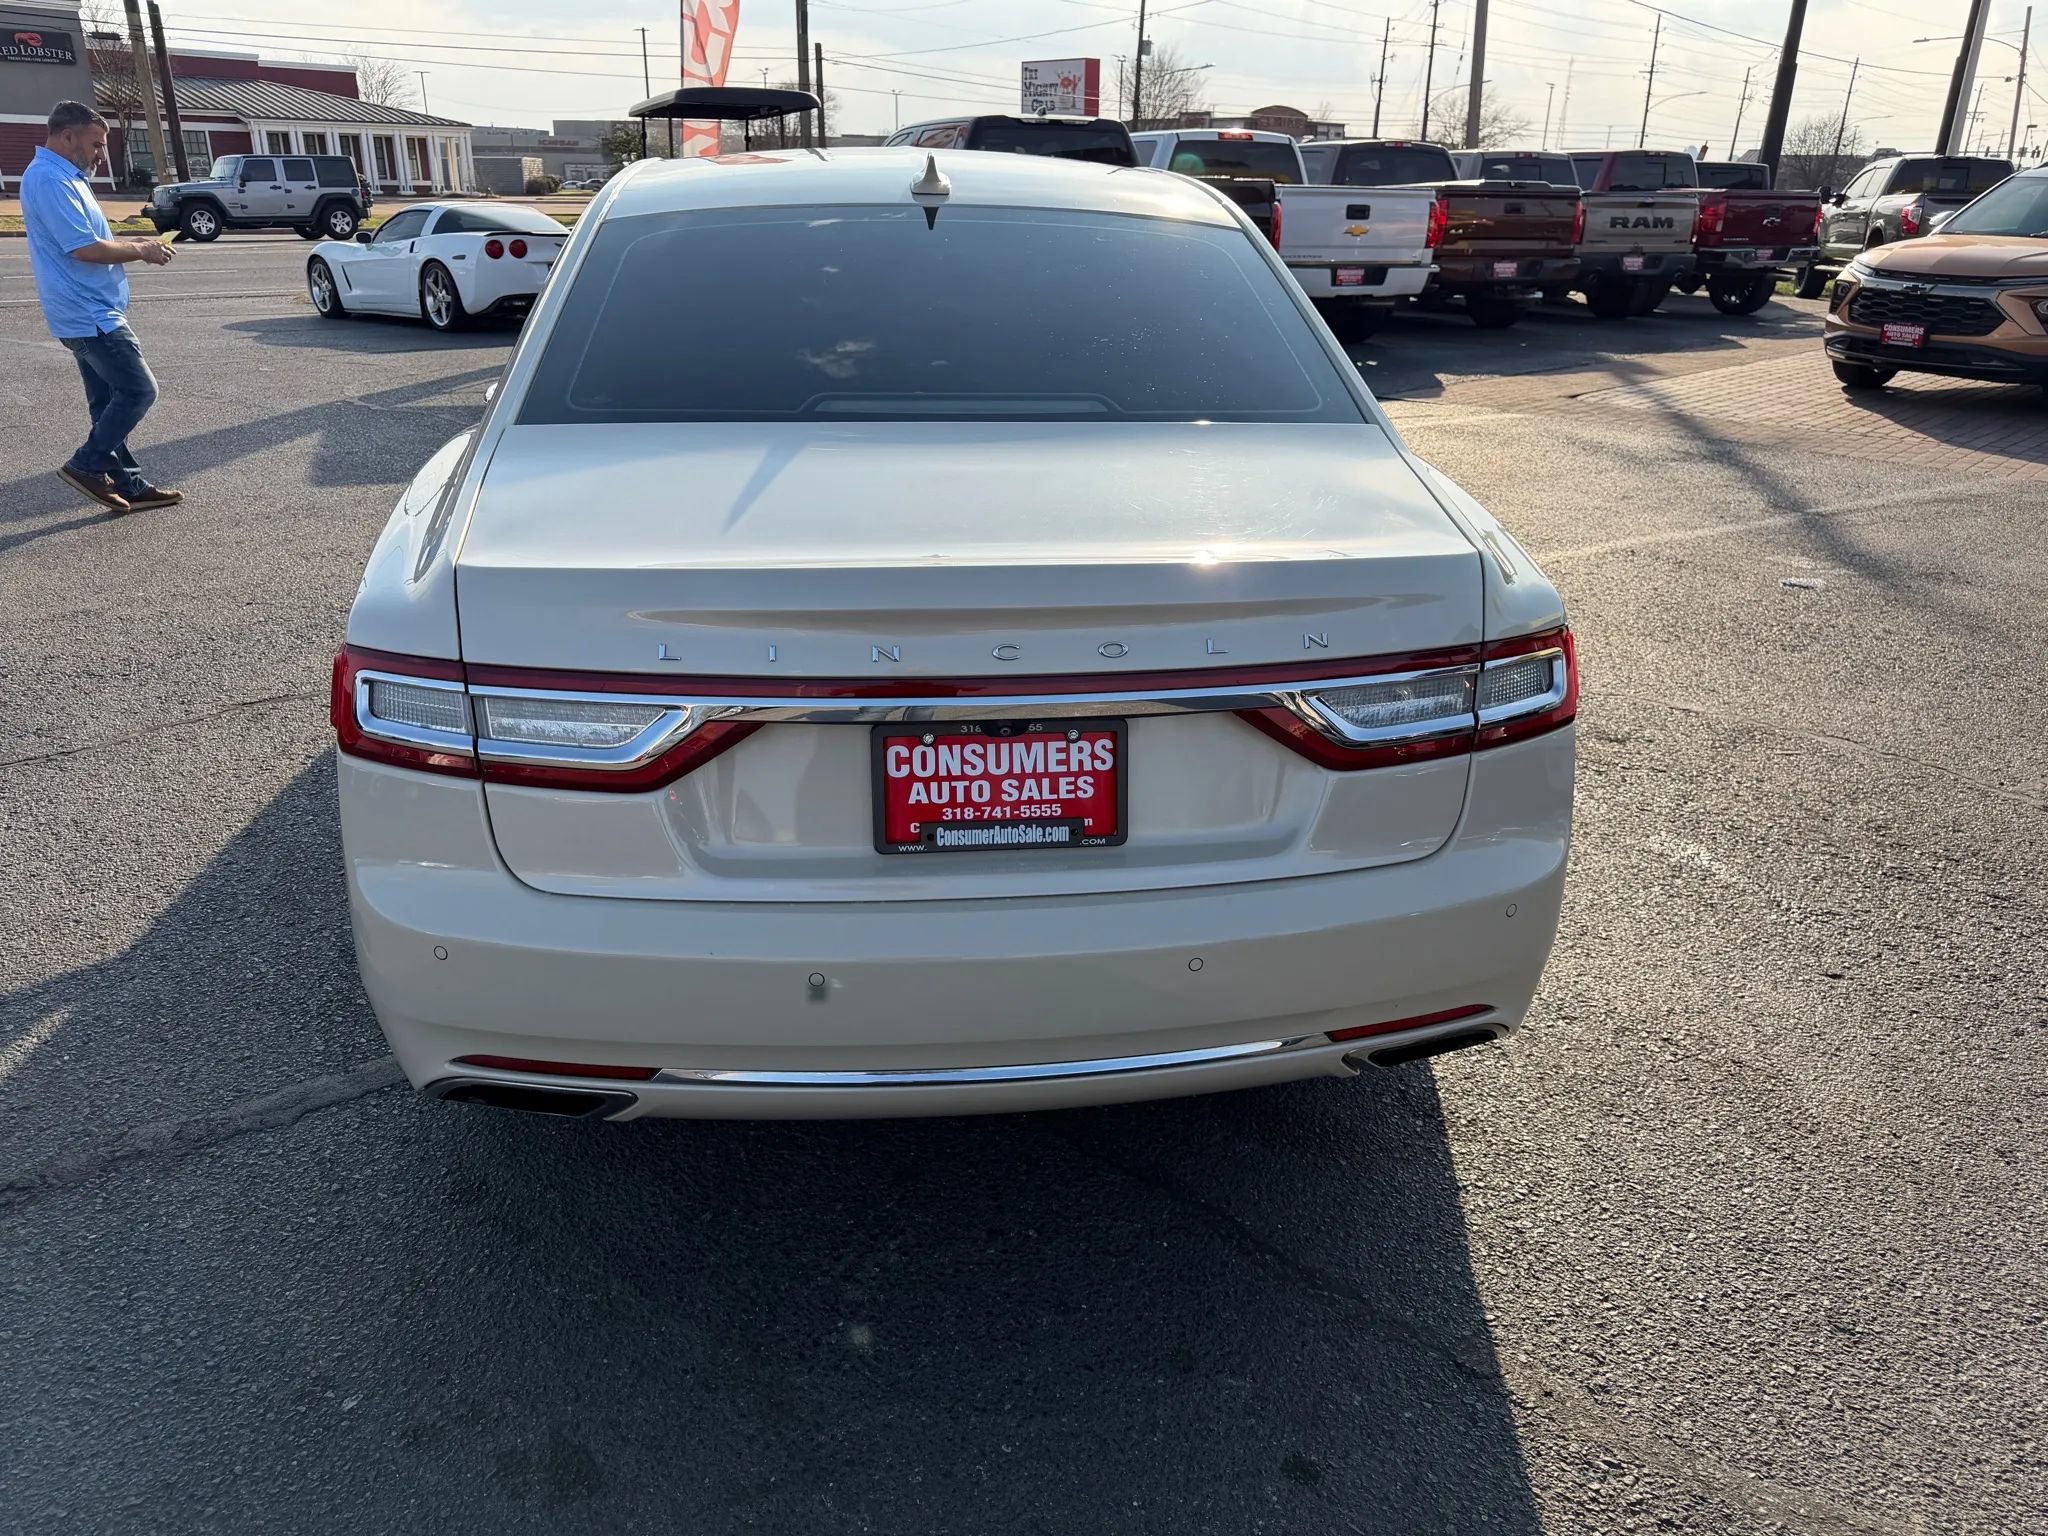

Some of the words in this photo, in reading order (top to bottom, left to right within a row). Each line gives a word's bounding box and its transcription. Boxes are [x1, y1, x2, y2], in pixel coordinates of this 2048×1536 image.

[0, 46, 18, 56] ED
[20, 44, 73, 60] LOBSTER
[1609, 216, 1675, 229] RAM
[1883, 323, 1924, 335] CONSUMERS
[1902, 332, 1919, 340] SALES
[657, 632, 1329, 662] LINCOLN
[886, 738, 1114, 778] CONSUMERS
[908, 780, 991, 805] AUTO
[1001, 776, 1095, 802] SALES
[942, 804, 1062, 820] 318-741-5555
[936, 823, 1070, 847] ConsumerAutoSale.com
[1079, 837, 1106, 845] .COM
